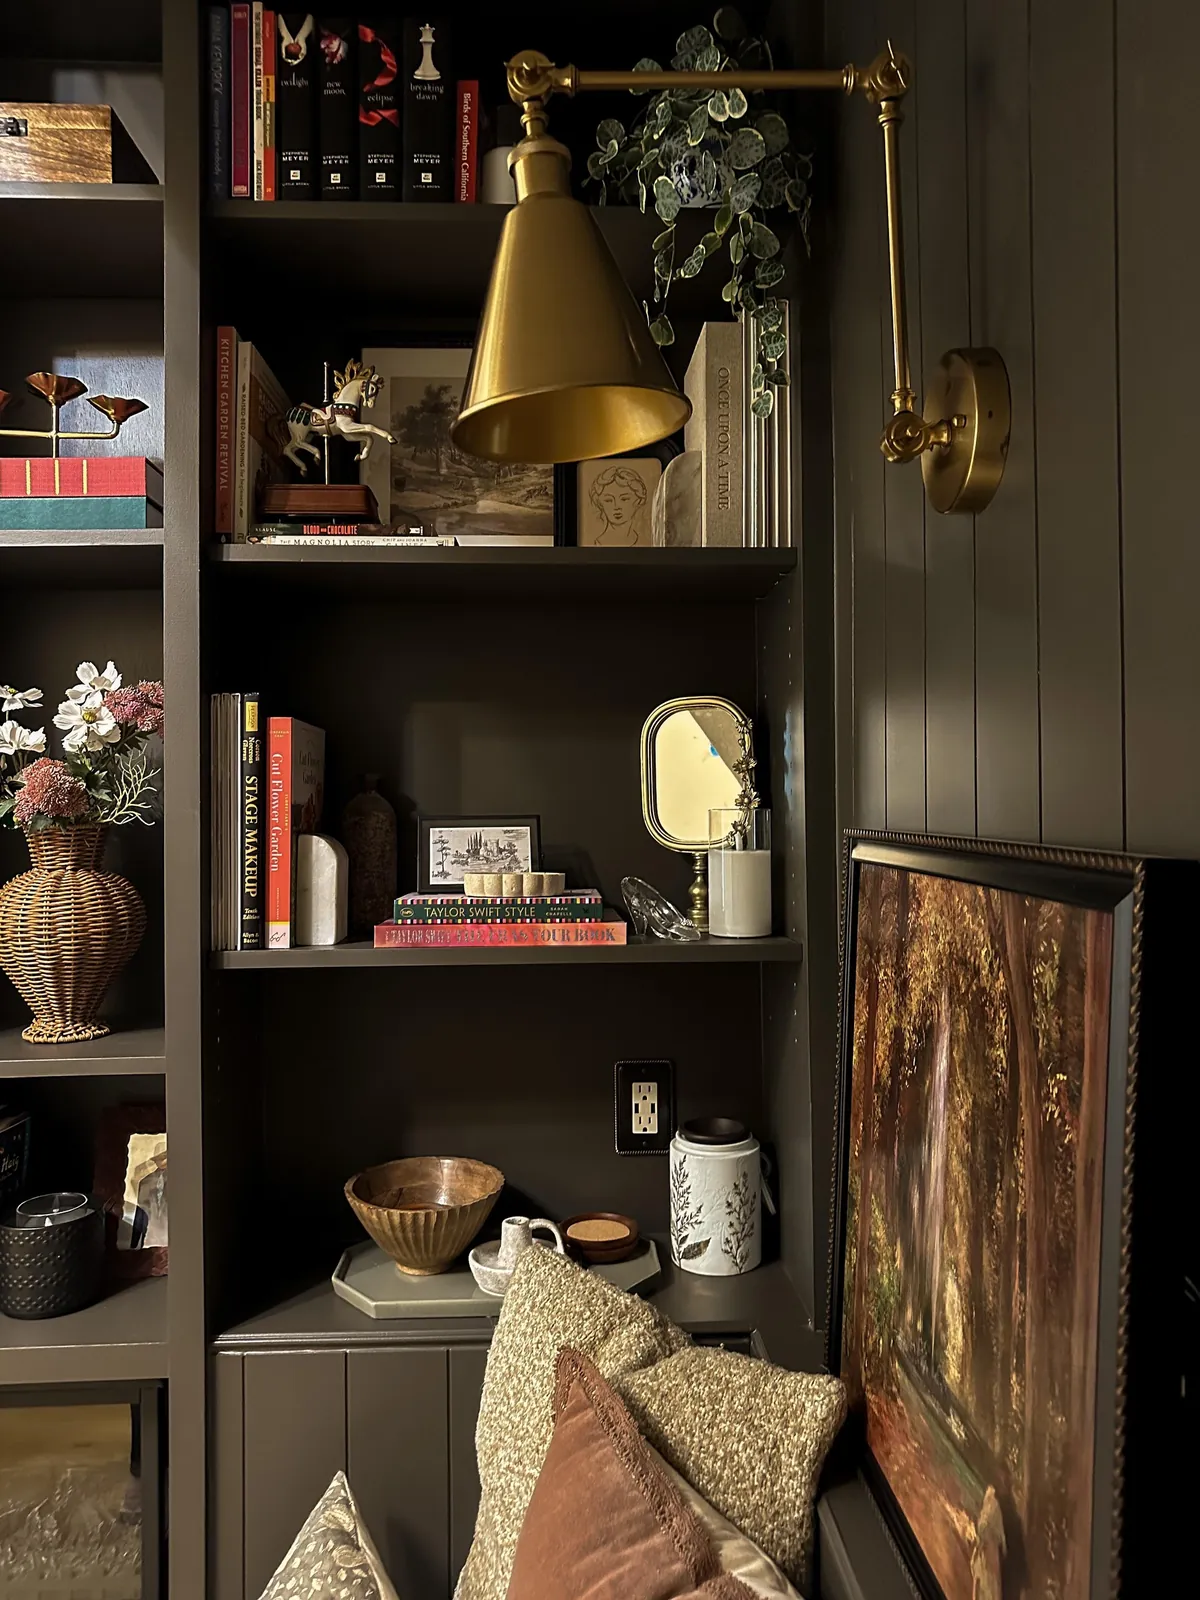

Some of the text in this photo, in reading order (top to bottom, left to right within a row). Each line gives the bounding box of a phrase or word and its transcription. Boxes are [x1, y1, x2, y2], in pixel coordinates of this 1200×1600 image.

[281, 72, 308, 88] twilight
[324, 88, 347, 96] moon
[410, 83, 444, 94] breaking
[367, 93, 394, 108] eclipse
[416, 93, 438, 101] dawn
[460, 92, 472, 201] Birds of Southern California
[219, 338, 229, 491] KITCHEN GARDEN REVIVAL
[717, 367, 731, 510] ONCE UPON A TIME
[303, 524, 320, 535] BLOOD
[328, 524, 359, 535] CHOCOLATE
[270, 753, 283, 872] Cut Flower Garden
[245, 775, 258, 898] STAGE MAKEUP
[424, 907, 466, 917] TAYLOR
[469, 907, 501, 917] SWIFT
[505, 907, 536, 917] STYLE
[391, 929, 423, 943] TAYLOR
[531, 929, 571, 942] TOUR
[575, 928, 616, 942] BOOK
